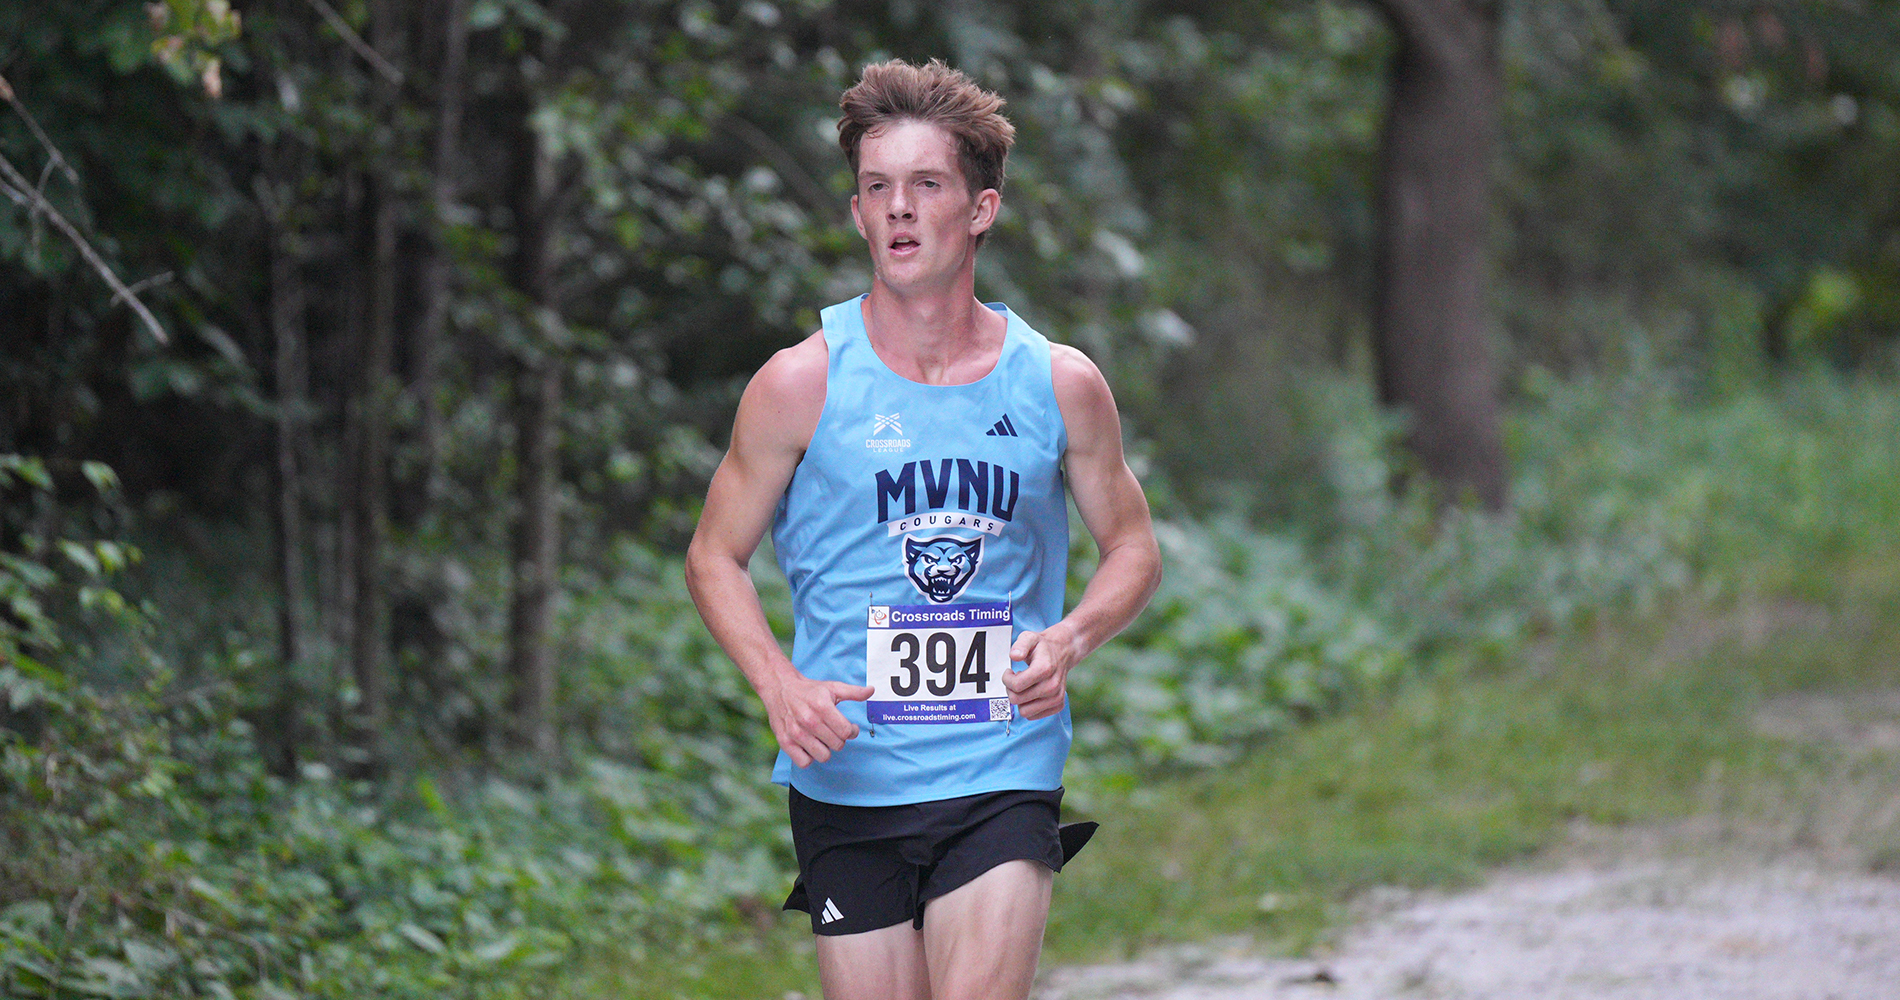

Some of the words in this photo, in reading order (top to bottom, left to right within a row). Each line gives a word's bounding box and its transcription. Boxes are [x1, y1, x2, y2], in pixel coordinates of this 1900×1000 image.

[866, 439, 911, 448] CROSSROADS
[875, 458, 1020, 524] MVNU
[900, 516, 994, 531] COUGARS
[891, 610, 966, 622] Crossroads
[969, 608, 1011, 622] Timing
[890, 630, 990, 697] 394
[903, 704, 919, 712] Live
[920, 704, 947, 712] Results
[882, 713, 976, 722] live.crossroadstiming.com
